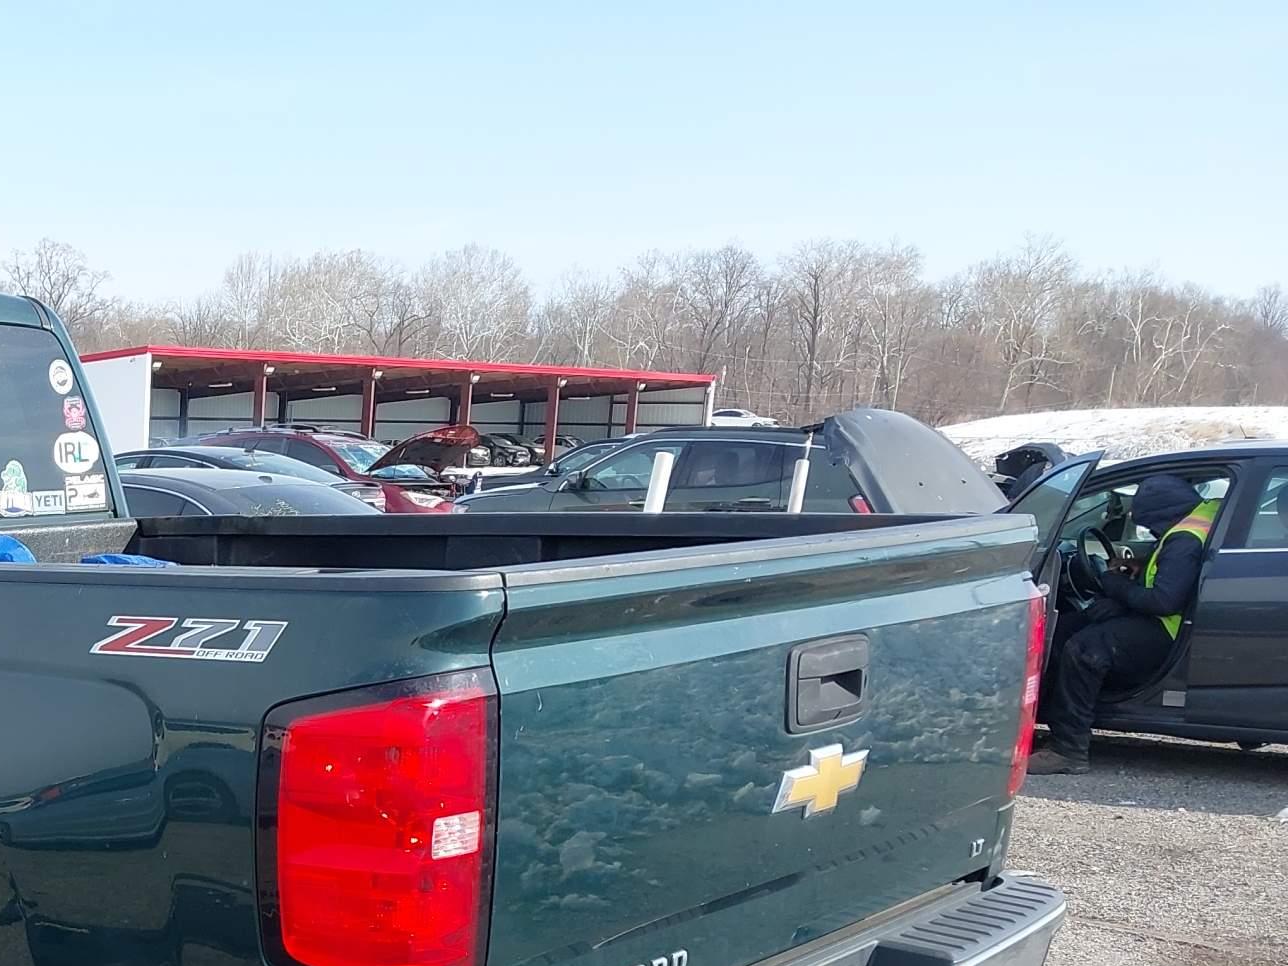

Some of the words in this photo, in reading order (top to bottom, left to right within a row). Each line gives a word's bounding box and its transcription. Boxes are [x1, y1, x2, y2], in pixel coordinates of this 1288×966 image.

[58, 441, 90, 464] IRL
[34, 494, 63, 508] YETI
[89, 615, 289, 662] Z71
[196, 648, 223, 658] OFF
[224, 650, 265, 660] ROAD
[970, 838, 986, 858] LT
